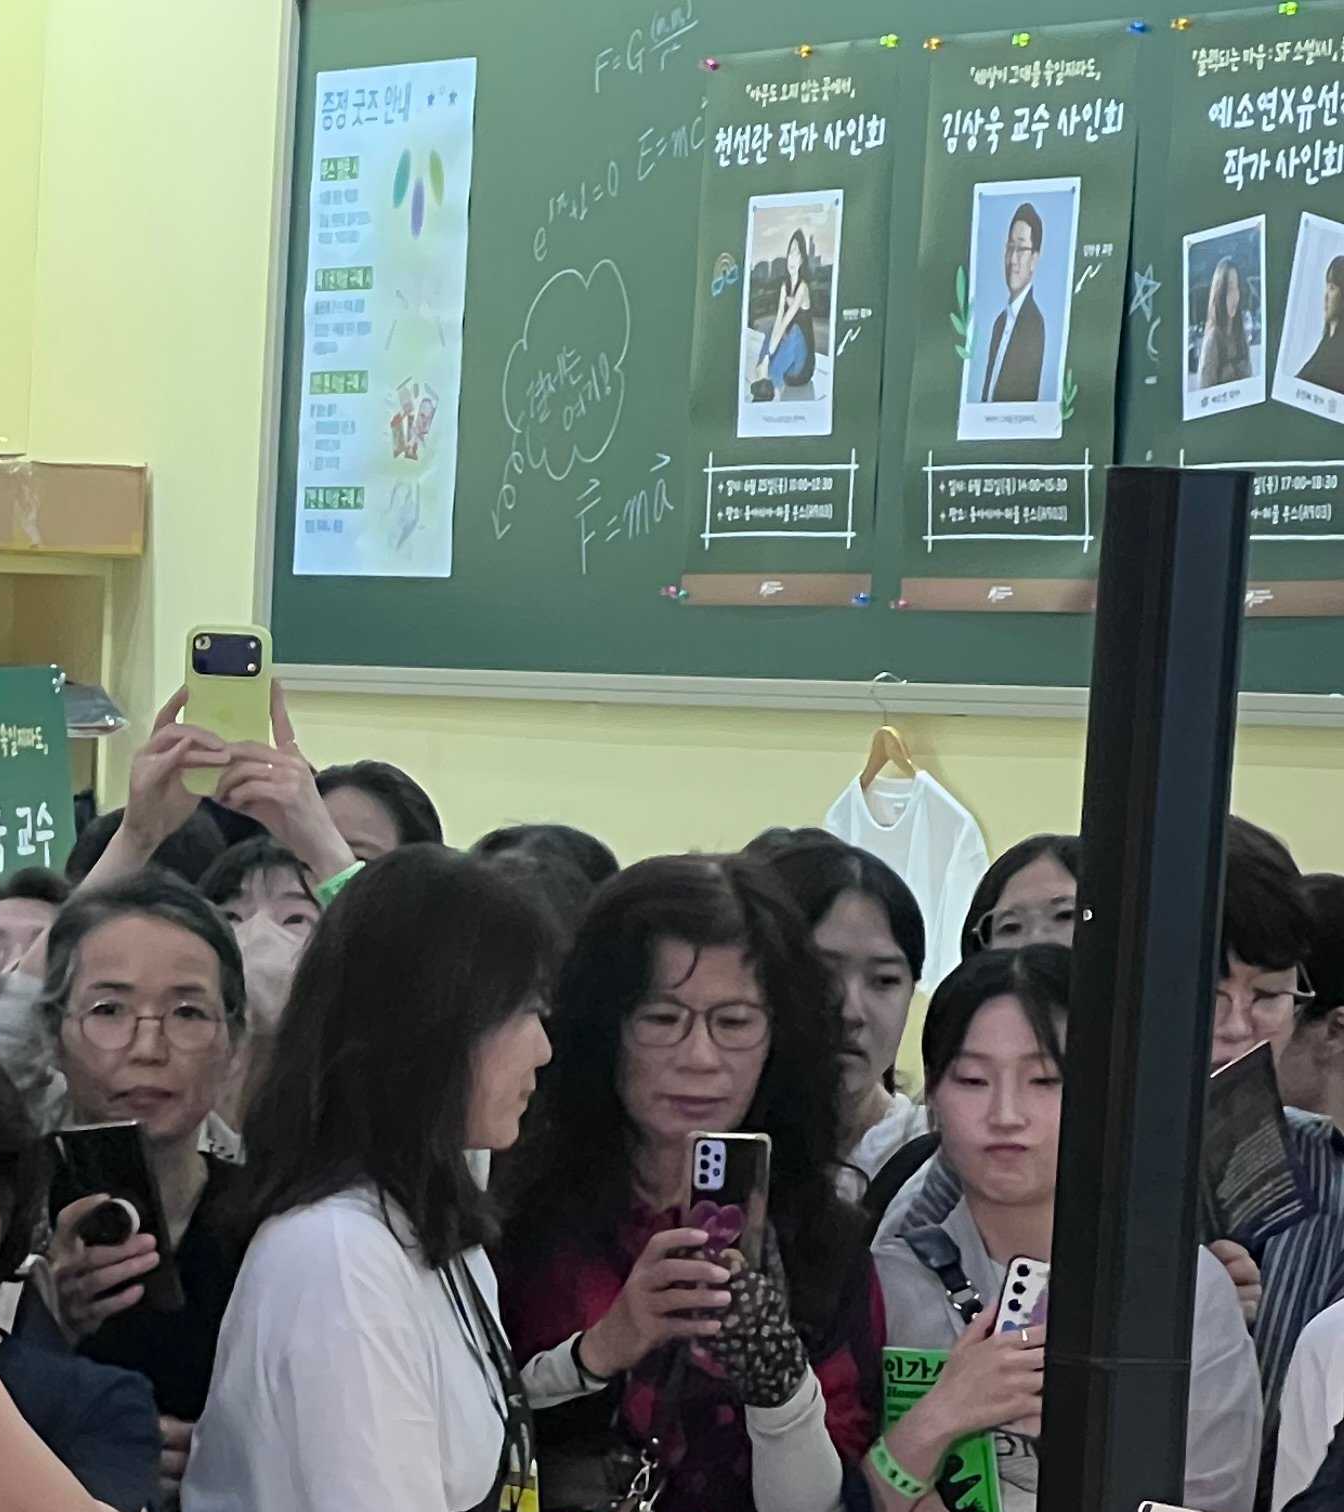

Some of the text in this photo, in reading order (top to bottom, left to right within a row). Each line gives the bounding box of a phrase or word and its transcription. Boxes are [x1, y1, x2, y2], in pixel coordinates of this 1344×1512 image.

[1274, 41, 1292, 62] SF
[322, 82, 411, 131] 증정 굿즈 안내
[942, 98, 1124, 154] 김상욱 교수 사인회
[715, 113, 886, 167] 천선란 작가 사인회
[1223, 139, 1344, 191] 작가 사인회
[16, 801, 54, 868] 교수
